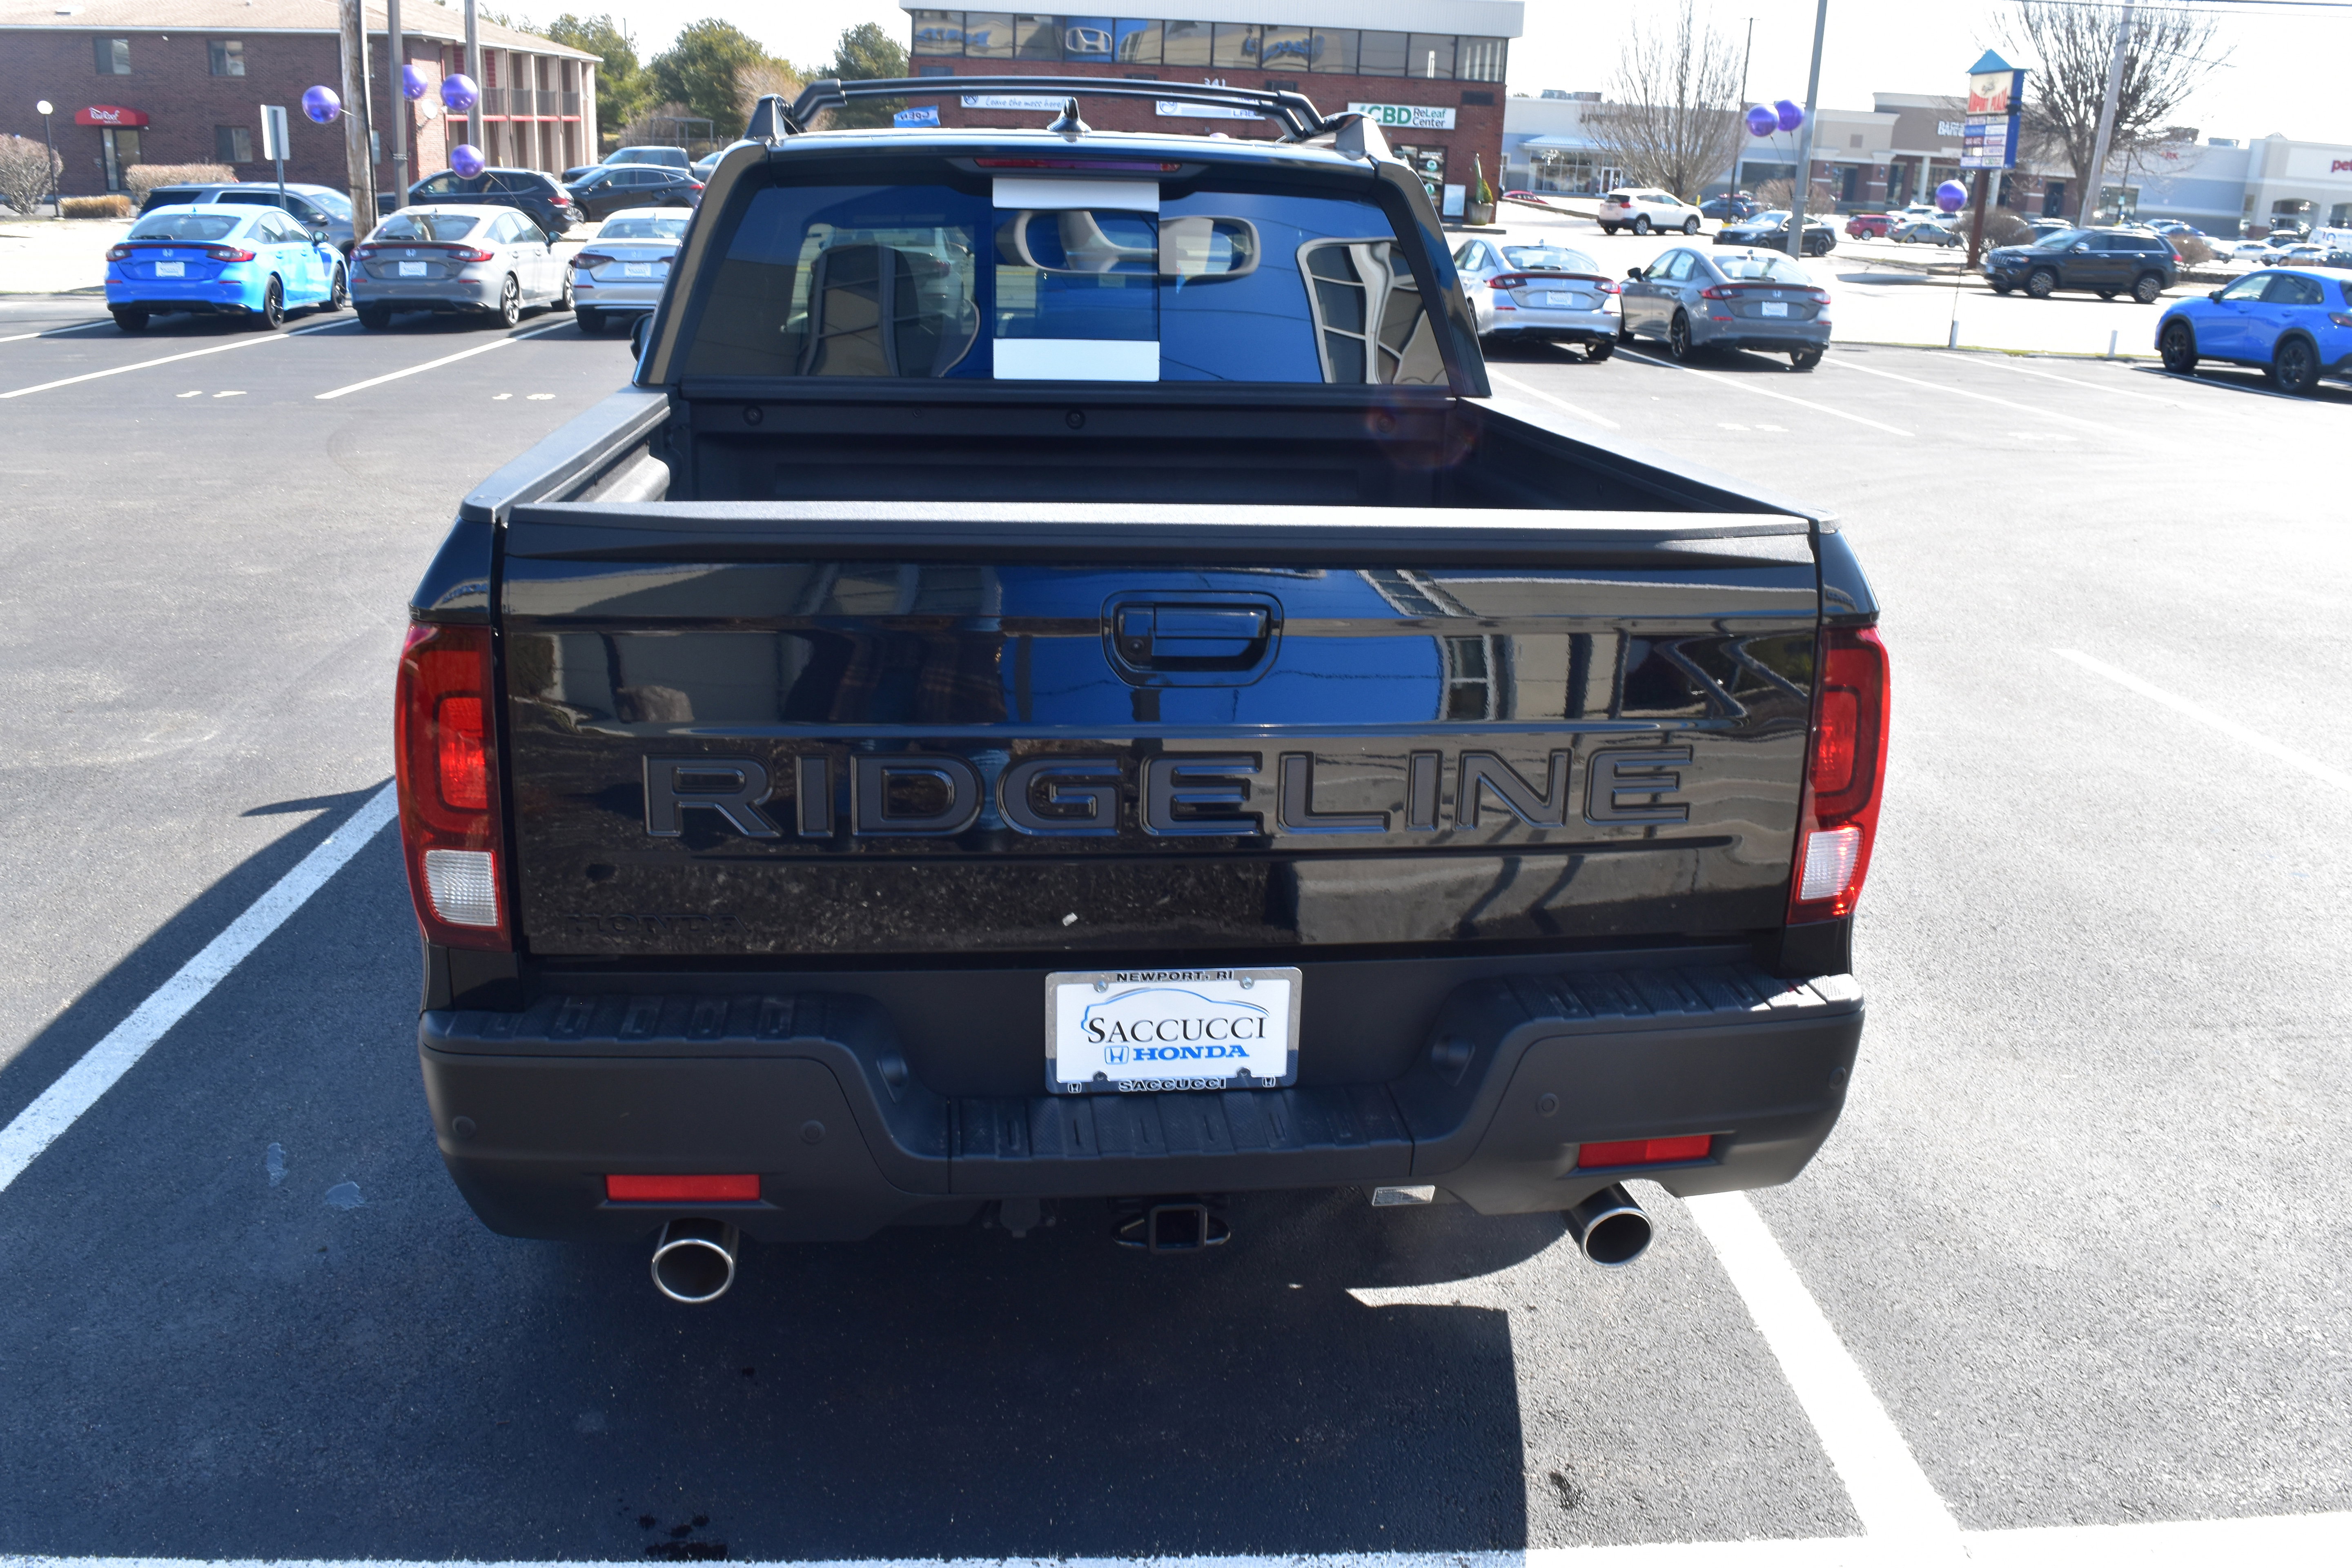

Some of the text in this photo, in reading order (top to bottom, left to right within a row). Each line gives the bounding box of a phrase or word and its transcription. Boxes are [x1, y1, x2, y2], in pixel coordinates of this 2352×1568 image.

[986, 96, 1007, 107] Leave
[1009, 98, 1022, 107] the
[1368, 106, 1412, 125] CBD
[1413, 107, 1447, 119] ReLeaf
[1412, 117, 1446, 128] Center
[643, 745, 1693, 838] RIDGELINE
[562, 913, 751, 934] HONDA
[1116, 970, 1234, 982] NEWPORT, RI
[1088, 1016, 1267, 1043] SACCUCCI
[1133, 1045, 1250, 1061] HONDA
[1118, 1077, 1226, 1092] SACCUCCI
